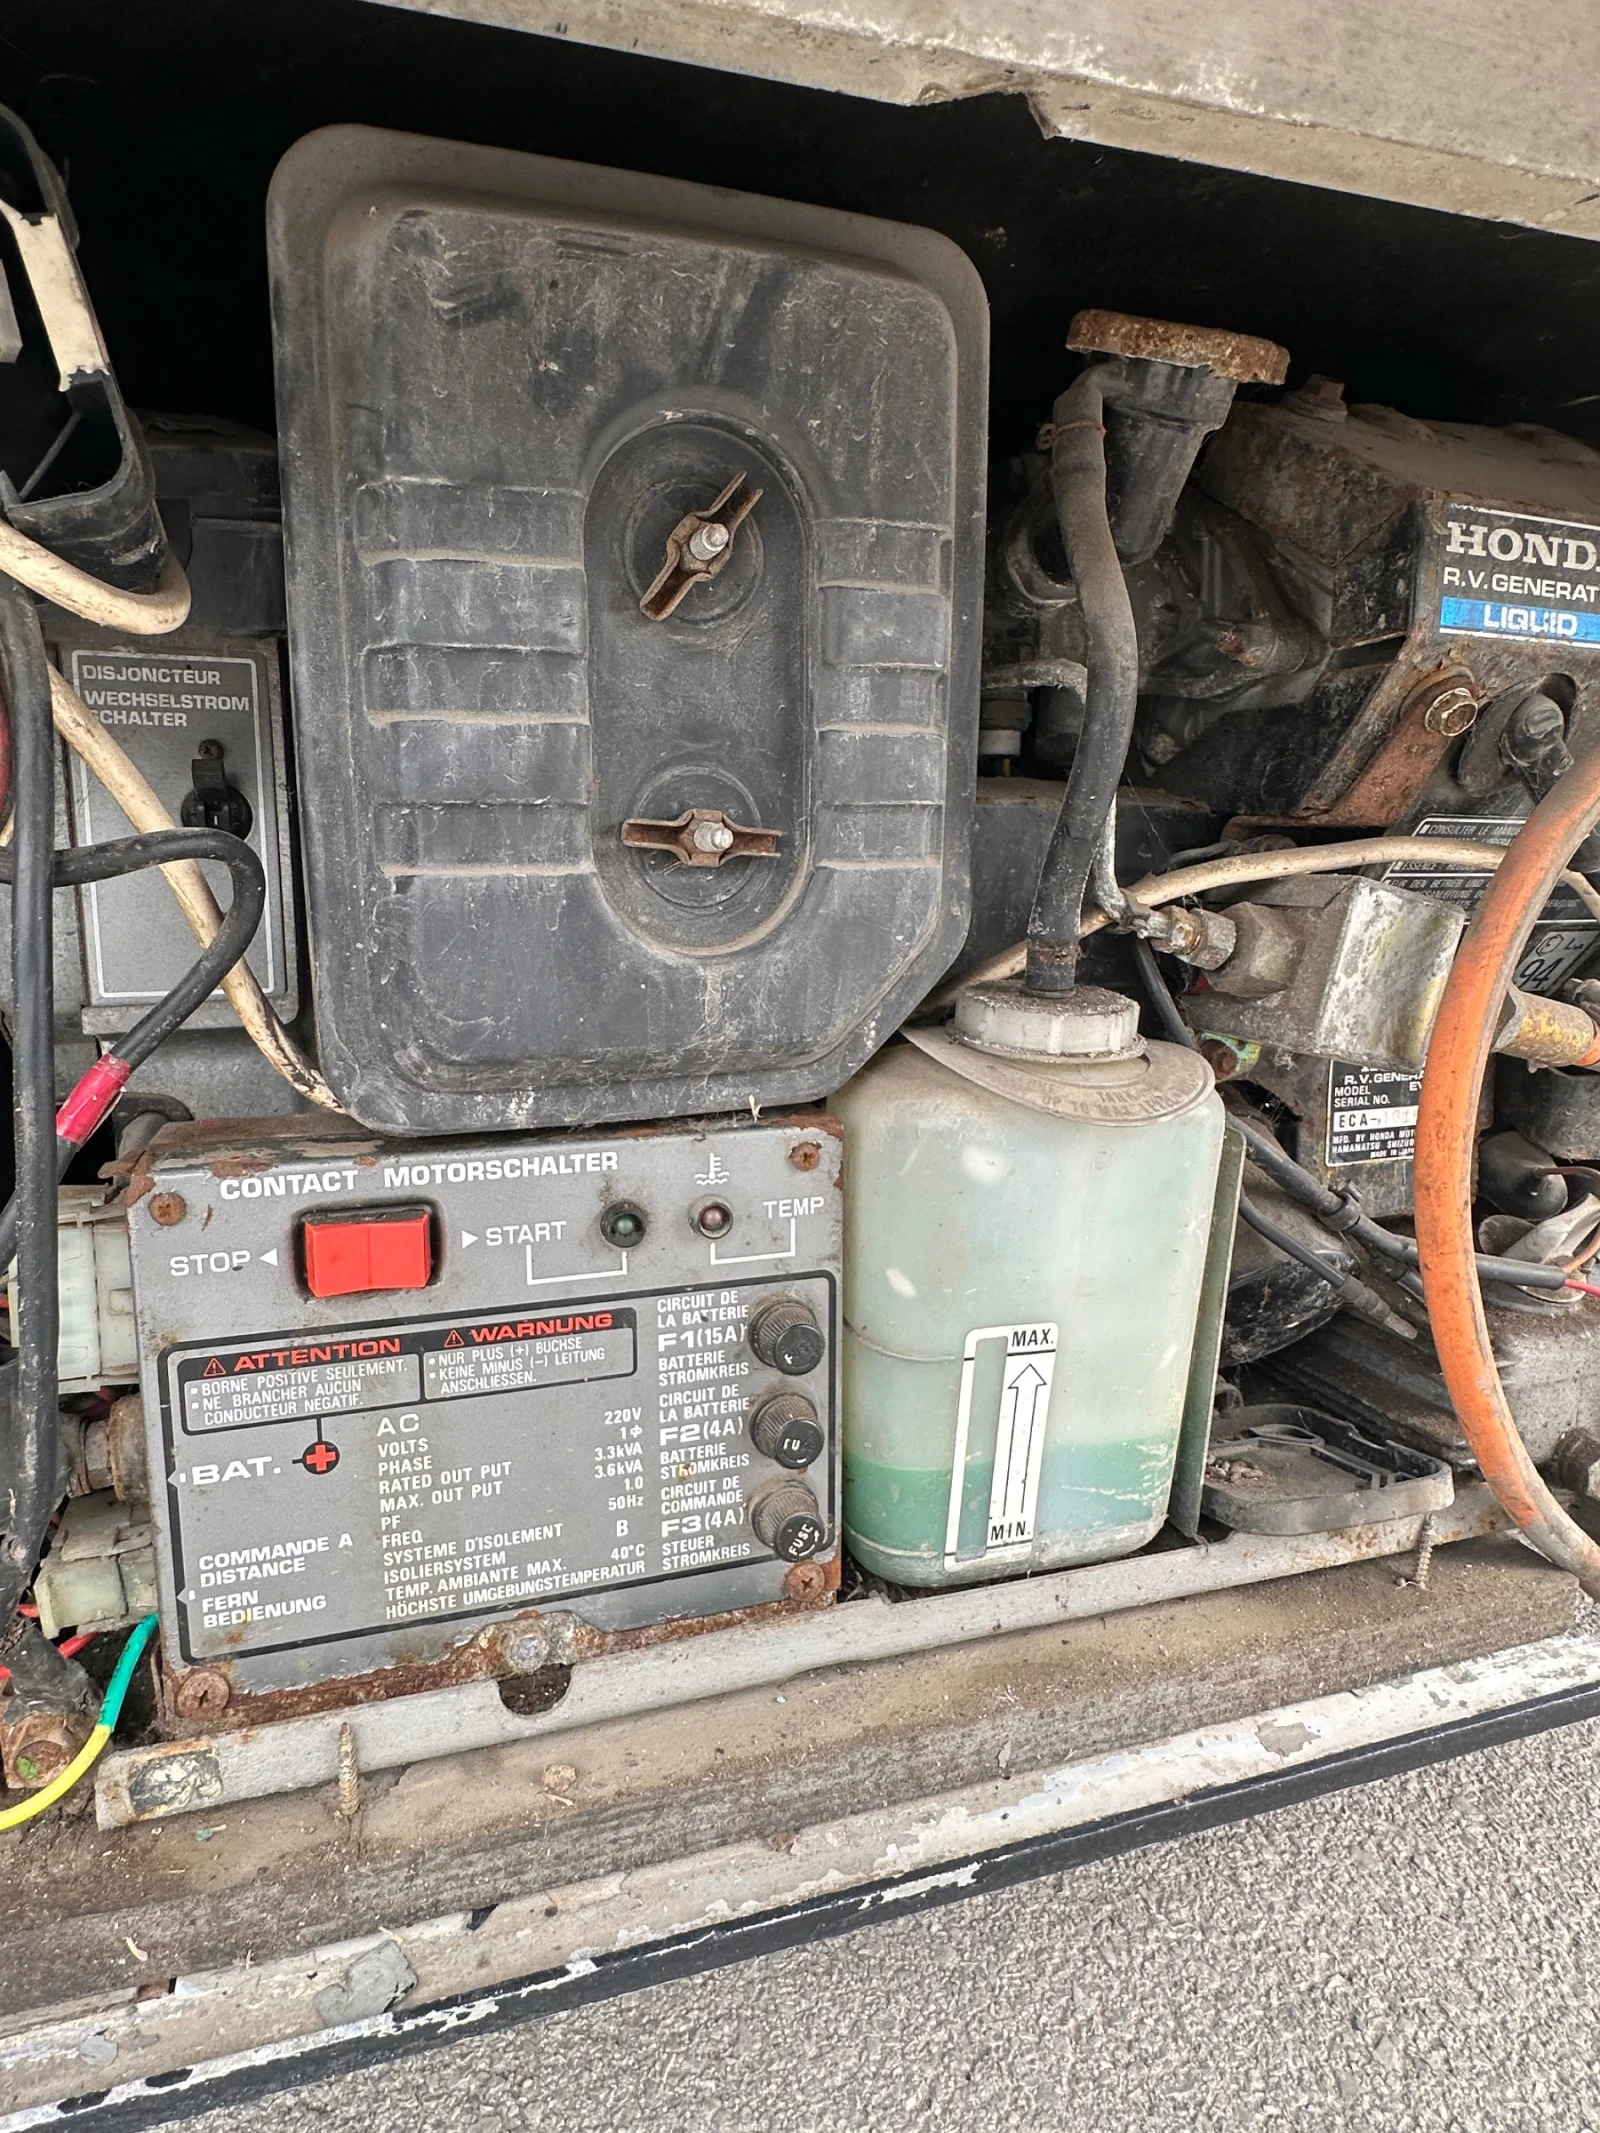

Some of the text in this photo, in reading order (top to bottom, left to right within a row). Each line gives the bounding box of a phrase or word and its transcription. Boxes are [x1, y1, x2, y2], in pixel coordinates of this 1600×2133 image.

[1446, 521, 1600, 573] HOND
[1483, 604, 1578, 636] LIQUID
[82, 665, 221, 685] DISJONCTEUR
[84, 690, 249, 711] WECHSELSTROM
[1334, 1085, 1371, 1097] MODEL
[1334, 1094, 1391, 1108] SERIAL NO.
[1355, 1133, 1366, 1142] BY
[1370, 1130, 1395, 1141] HONDA
[1399, 1129, 1416, 1139] MOT
[220, 1151, 619, 1200] CONTACT MOTORSCHALTER
[762, 1196, 825, 1218] TEMP
[485, 1220, 567, 1246] START
[170, 1250, 251, 1277] STOP
[657, 1290, 739, 1313] CIRCUIT DE
[471, 1313, 613, 1343] WARNUNG
[657, 1304, 750, 1329] LA BATTERIE
[438, 1336, 583, 1367] NUR PLUS (+) BUCHSE
[1011, 1329, 1054, 1348] MAX.
[234, 1338, 401, 1372] ATTENTION
[439, 1365, 476, 1381] KEINE
[482, 1358, 524, 1375] MINUS
[554, 1347, 606, 1366] LEITUNG
[658, 1350, 726, 1371] BATTERIE
[201, 1359, 408, 1396] BORNE POSITIVE SEULEMENT.
[440, 1371, 537, 1395] ANSCHLIESSEN.
[658, 1362, 750, 1387] STROMKREIS
[203, 1379, 362, 1411] NE BRANCHER AUCUN
[659, 1384, 740, 1408] CIRCUIT DE
[204, 1393, 364, 1426] CONDUCTEUR NEGATIF.
[659, 1397, 751, 1423] LA BATTERIE
[377, 1406, 643, 1458] VOLTS 220V
[378, 1456, 433, 1477] PHASE
[660, 1442, 727, 1466] BATTERIE
[660, 1454, 751, 1480] STROMKREIS
[191, 1456, 281, 1486] BAT.
[379, 1442, 643, 1496] RATED OUT PUT 3.3kVA
[380, 1459, 644, 1515] MAX. OUT PUT 3.6kVA
[660, 1475, 741, 1501] CIRCUIT DE
[381, 1476, 644, 1531] PF 1.0
[661, 1490, 744, 1515] COMMANDE
[382, 1495, 644, 1550] FREQ 50Hz
[616, 1519, 629, 1537] B
[990, 1521, 1030, 1541] MIN.
[198, 1532, 354, 1571] COMMANDE A
[383, 1523, 564, 1567] SYSTEME D'ISOLEMENT
[662, 1534, 715, 1557] STEUER
[662, 1543, 751, 1572] STROMKREIS
[200, 1557, 307, 1589] DISTANCE
[384, 1551, 507, 1585] ISOLIERSYSTEM
[385, 1544, 646, 1602] TEMP. AMBIANTE MAX. 40°C
[202, 1589, 260, 1614] FERN
[386, 1560, 646, 1620] HÖCHSTE UMGEBUNGSTEMPERATUR
[203, 1594, 328, 1629] BEDIENUNG
